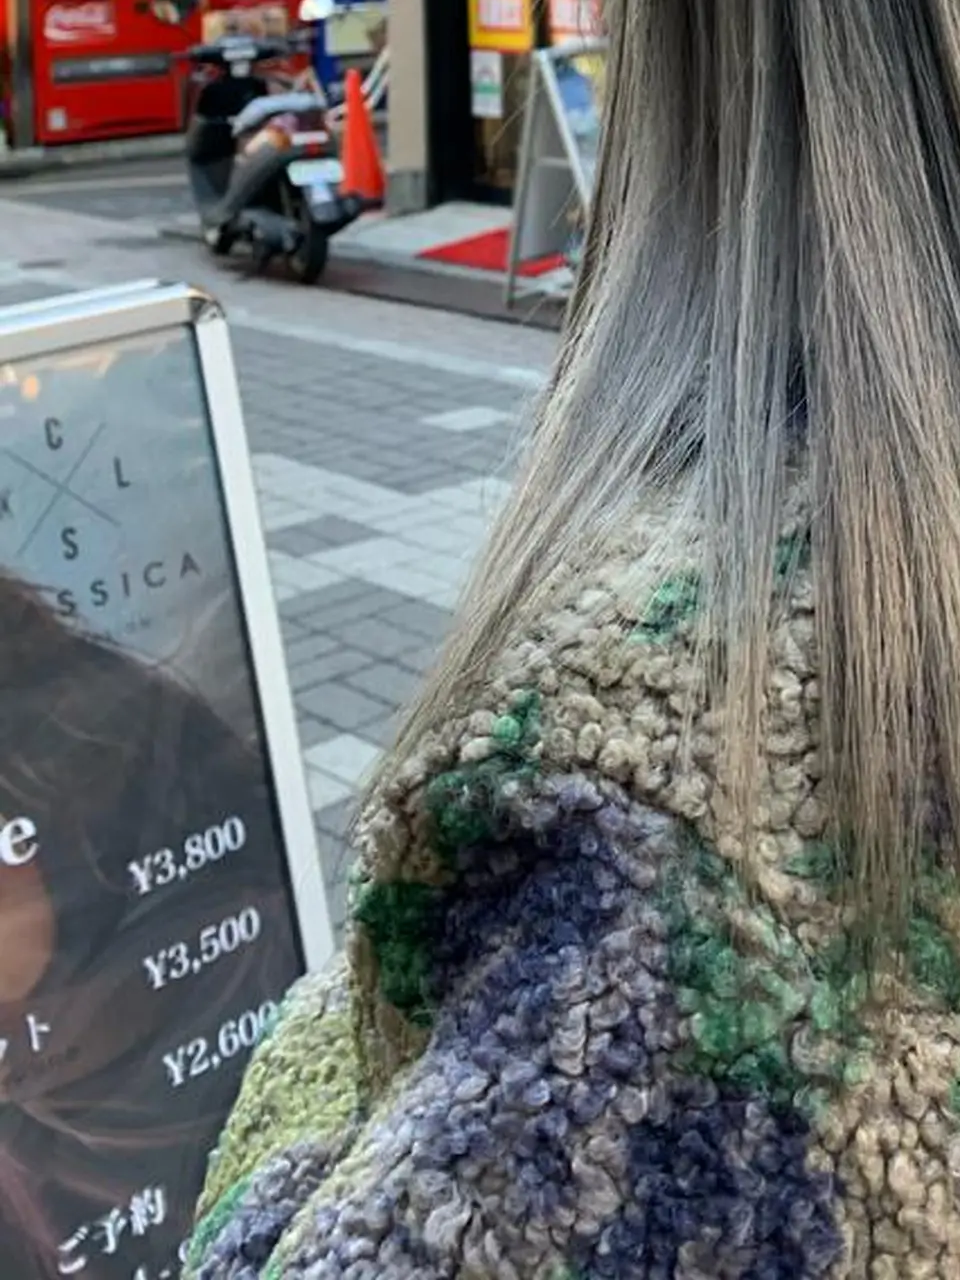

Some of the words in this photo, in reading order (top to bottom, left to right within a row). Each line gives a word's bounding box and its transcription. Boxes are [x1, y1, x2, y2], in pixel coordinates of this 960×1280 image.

[127, 817, 246, 895] ¥3,800
[143, 907, 260, 990] ¥3,500
[57, 1186, 167, 1274] ご予約
